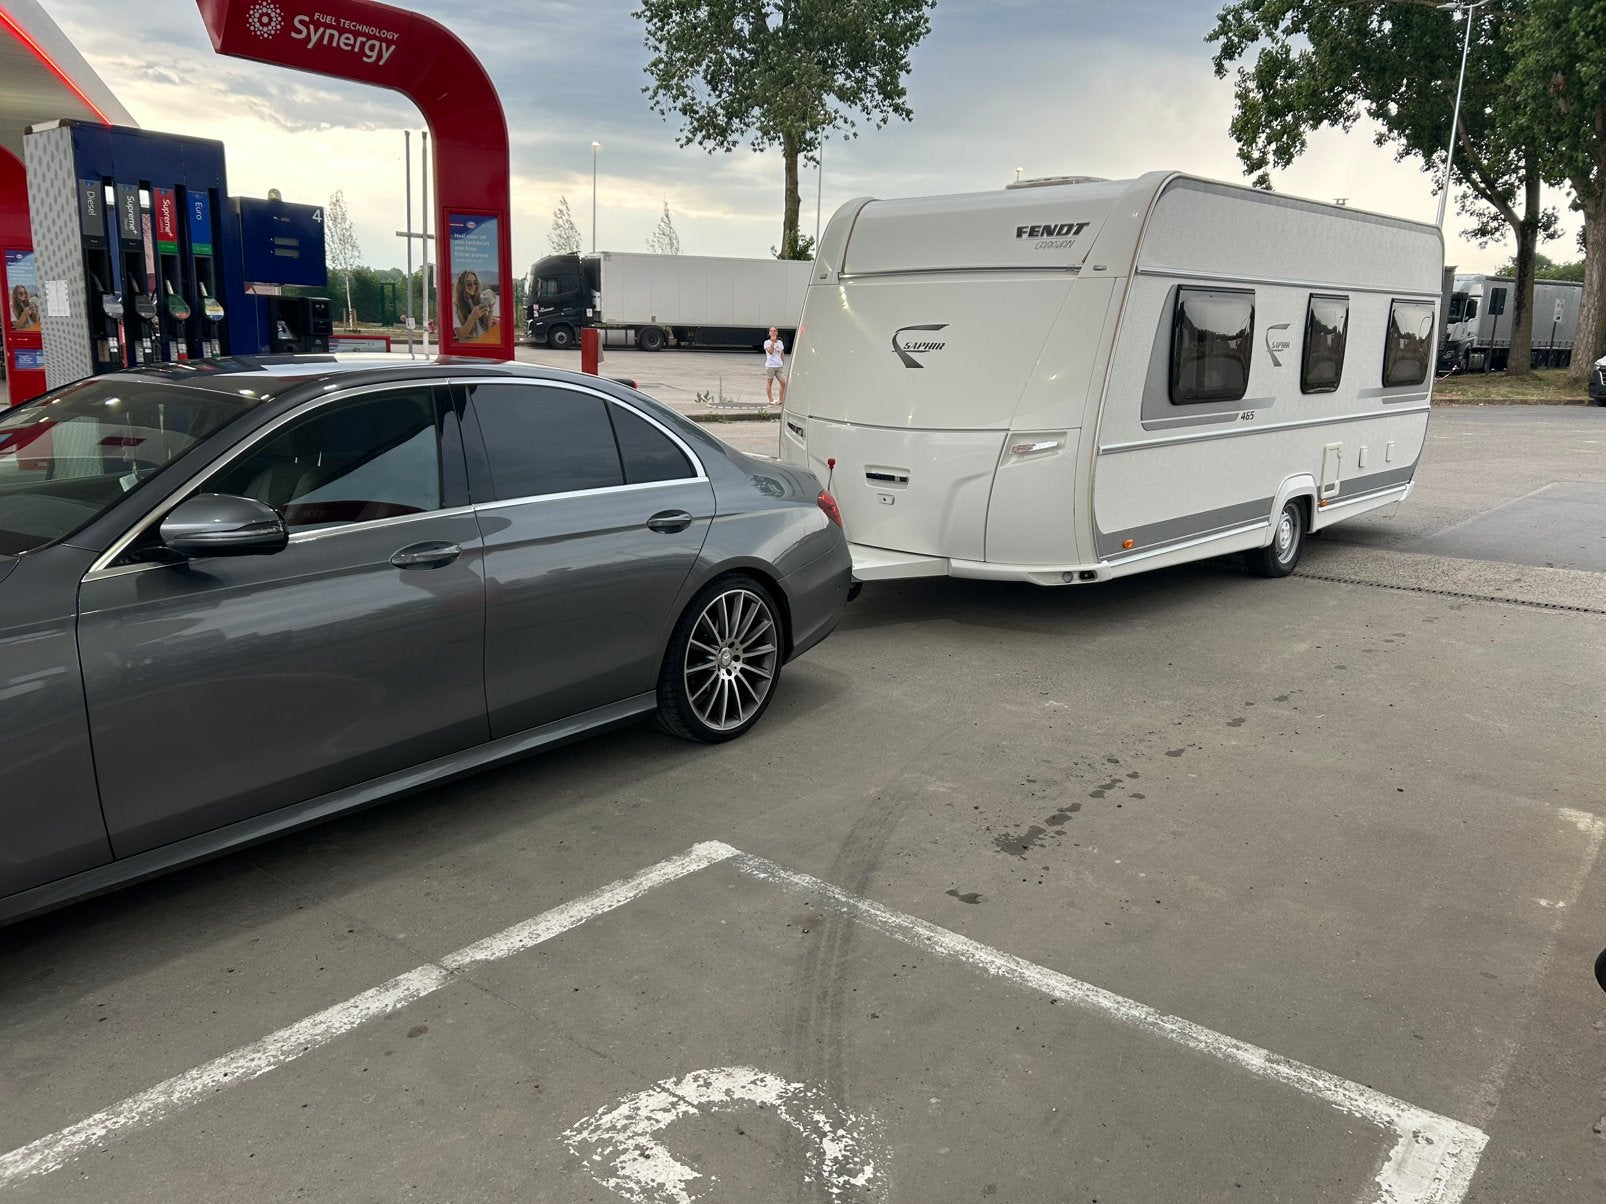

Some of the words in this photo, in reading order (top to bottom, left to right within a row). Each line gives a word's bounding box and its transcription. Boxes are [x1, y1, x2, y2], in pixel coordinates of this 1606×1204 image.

[314, 12, 337, 26] FUEL
[339, 18, 400, 41] TECHNOLOGY
[290, 15, 397, 66] Synergy
[86, 190, 97, 217] Diesel
[195, 202, 203, 221] Euro
[312, 209, 323, 223] 4
[1016, 221, 1091, 239] FENDT
[903, 341, 946, 350] SAPHIR
[1241, 411, 1255, 421] 465
